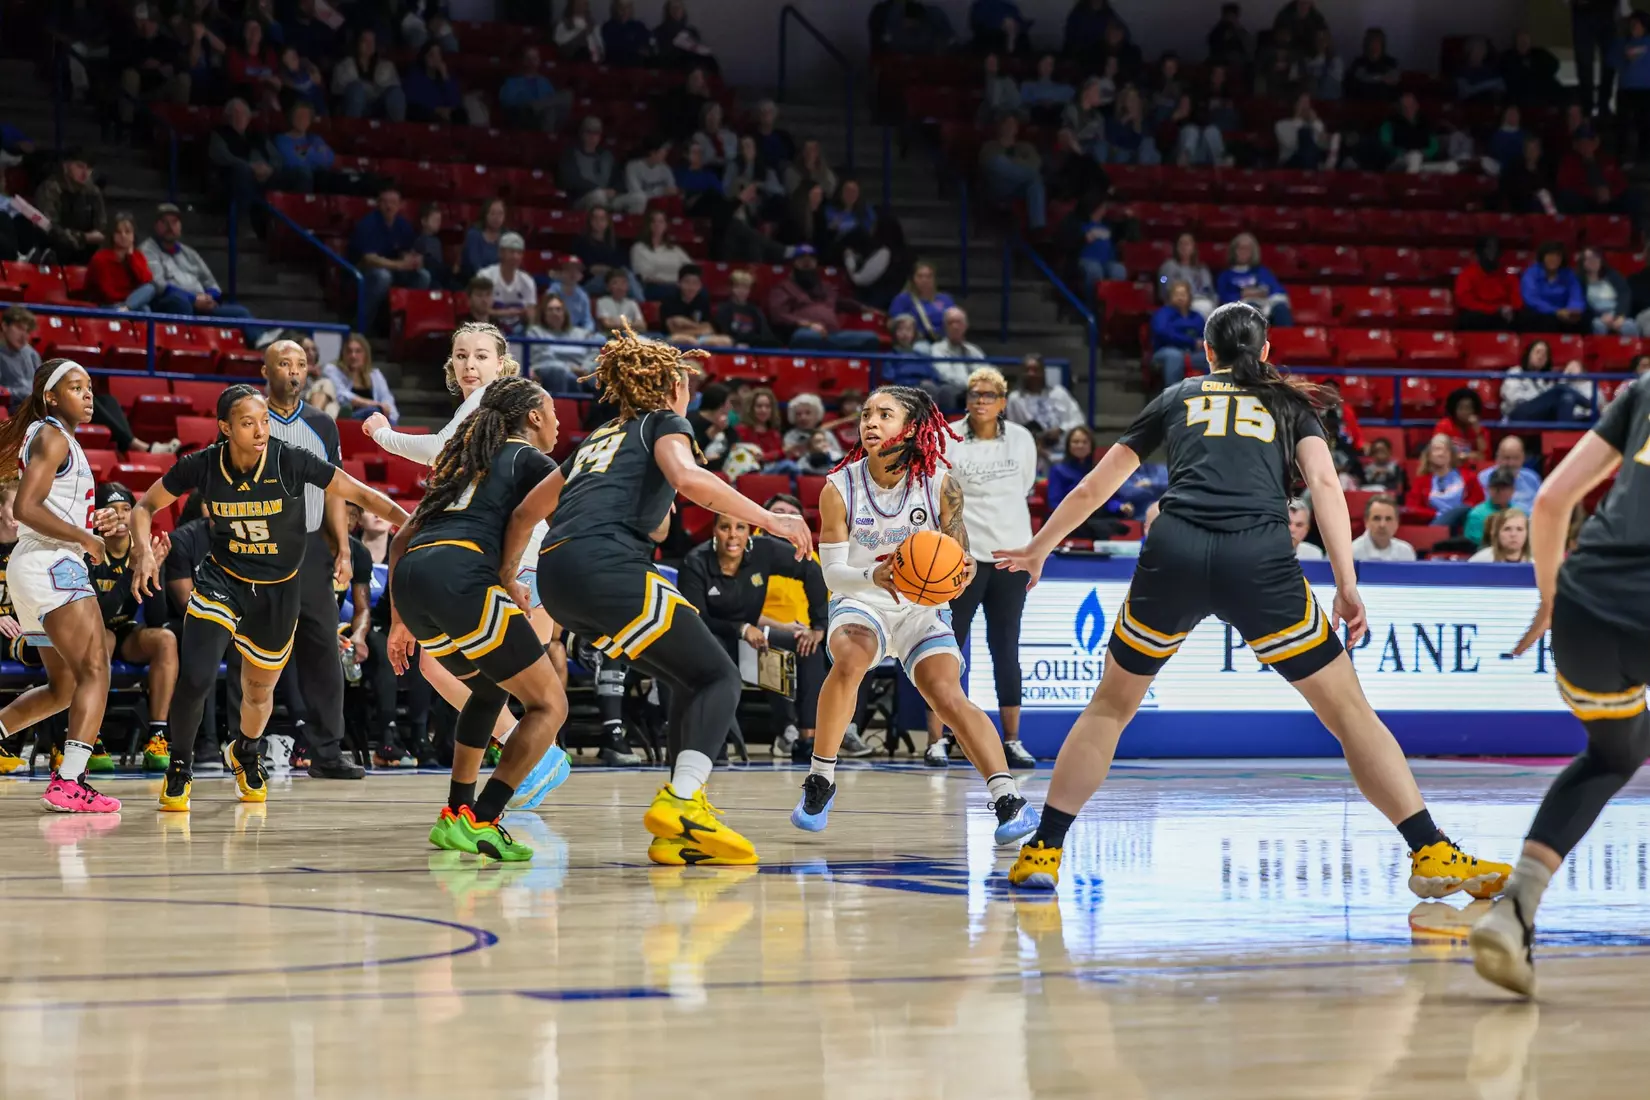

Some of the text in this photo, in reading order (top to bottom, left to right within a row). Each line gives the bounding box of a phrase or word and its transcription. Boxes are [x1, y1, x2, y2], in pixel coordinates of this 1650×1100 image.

[1201, 380, 1247, 392] CULL
[1184, 395, 1276, 443] 45
[212, 498, 283, 518] KENNESAW
[229, 520, 270, 542] 15
[228, 539, 279, 555] STATE
[1220, 622, 1480, 673] PPANE
[1020, 687, 1081, 700] ROPANE
